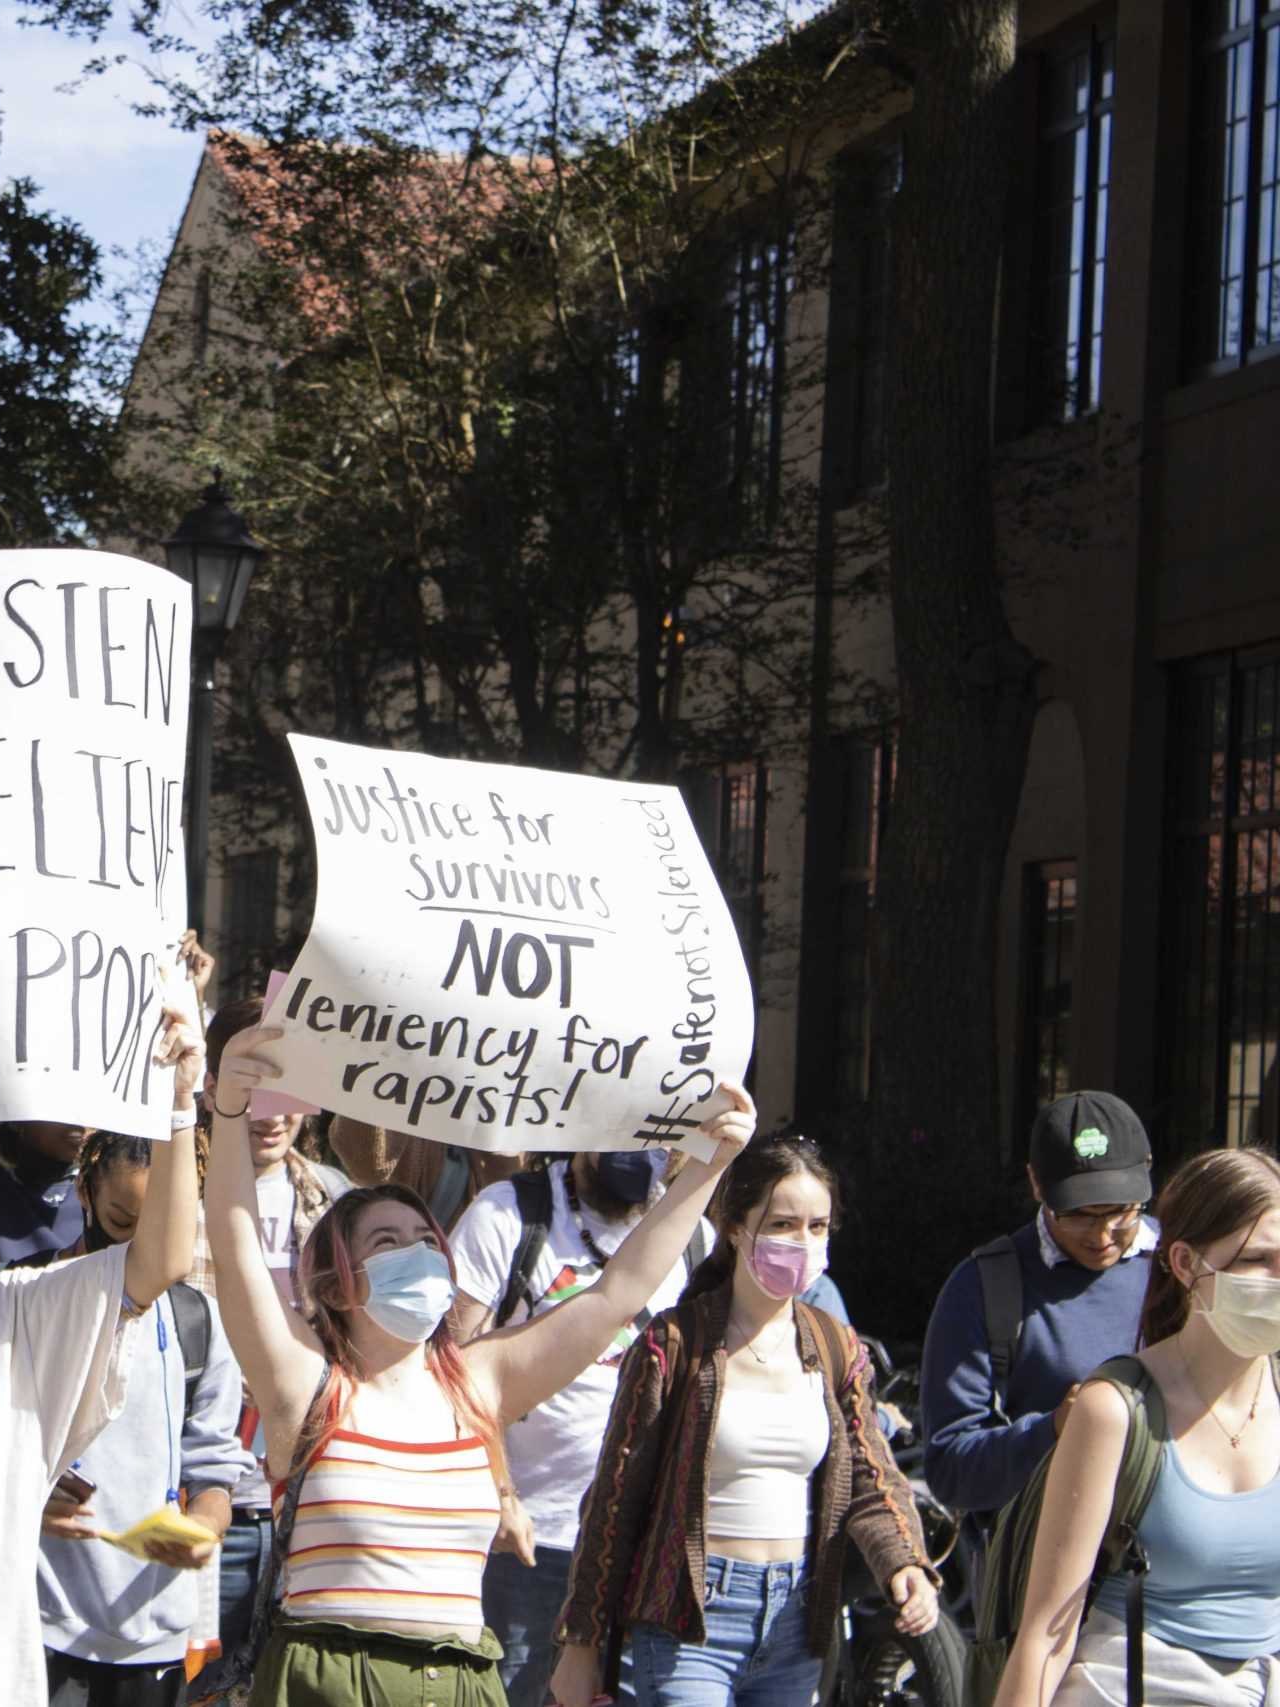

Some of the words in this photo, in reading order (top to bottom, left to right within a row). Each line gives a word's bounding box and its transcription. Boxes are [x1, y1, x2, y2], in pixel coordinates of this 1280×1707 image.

[313, 757, 479, 845] justice
[489, 792, 555, 846] for
[441, 919, 595, 1009] NOT
[285, 977, 539, 1083] leniency
[558, 1015, 650, 1081] for
[341, 1062, 588, 1130] rapists!
